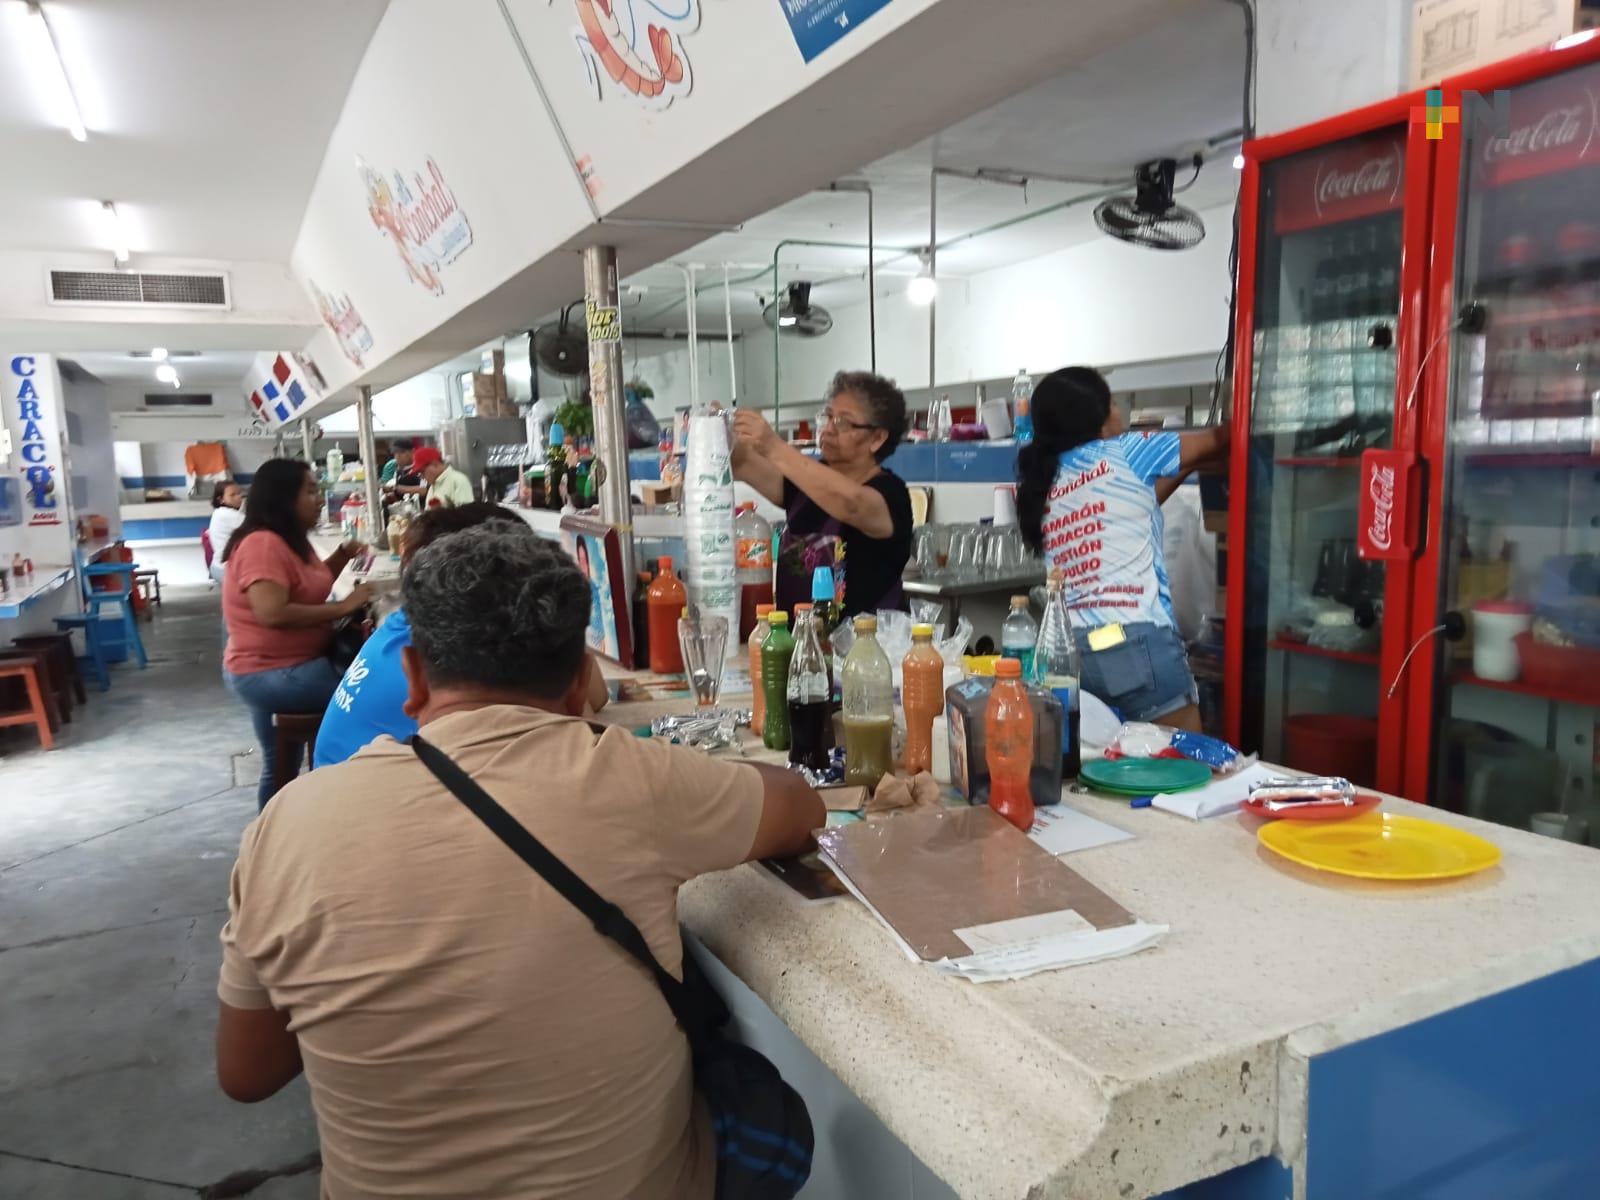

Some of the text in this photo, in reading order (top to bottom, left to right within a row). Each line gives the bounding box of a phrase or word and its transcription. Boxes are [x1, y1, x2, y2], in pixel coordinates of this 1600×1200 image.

[11, 356, 56, 508] CARACOL
[1041, 501, 1106, 535] AMARÓN
[1053, 538, 1103, 566] OSTIÓN
